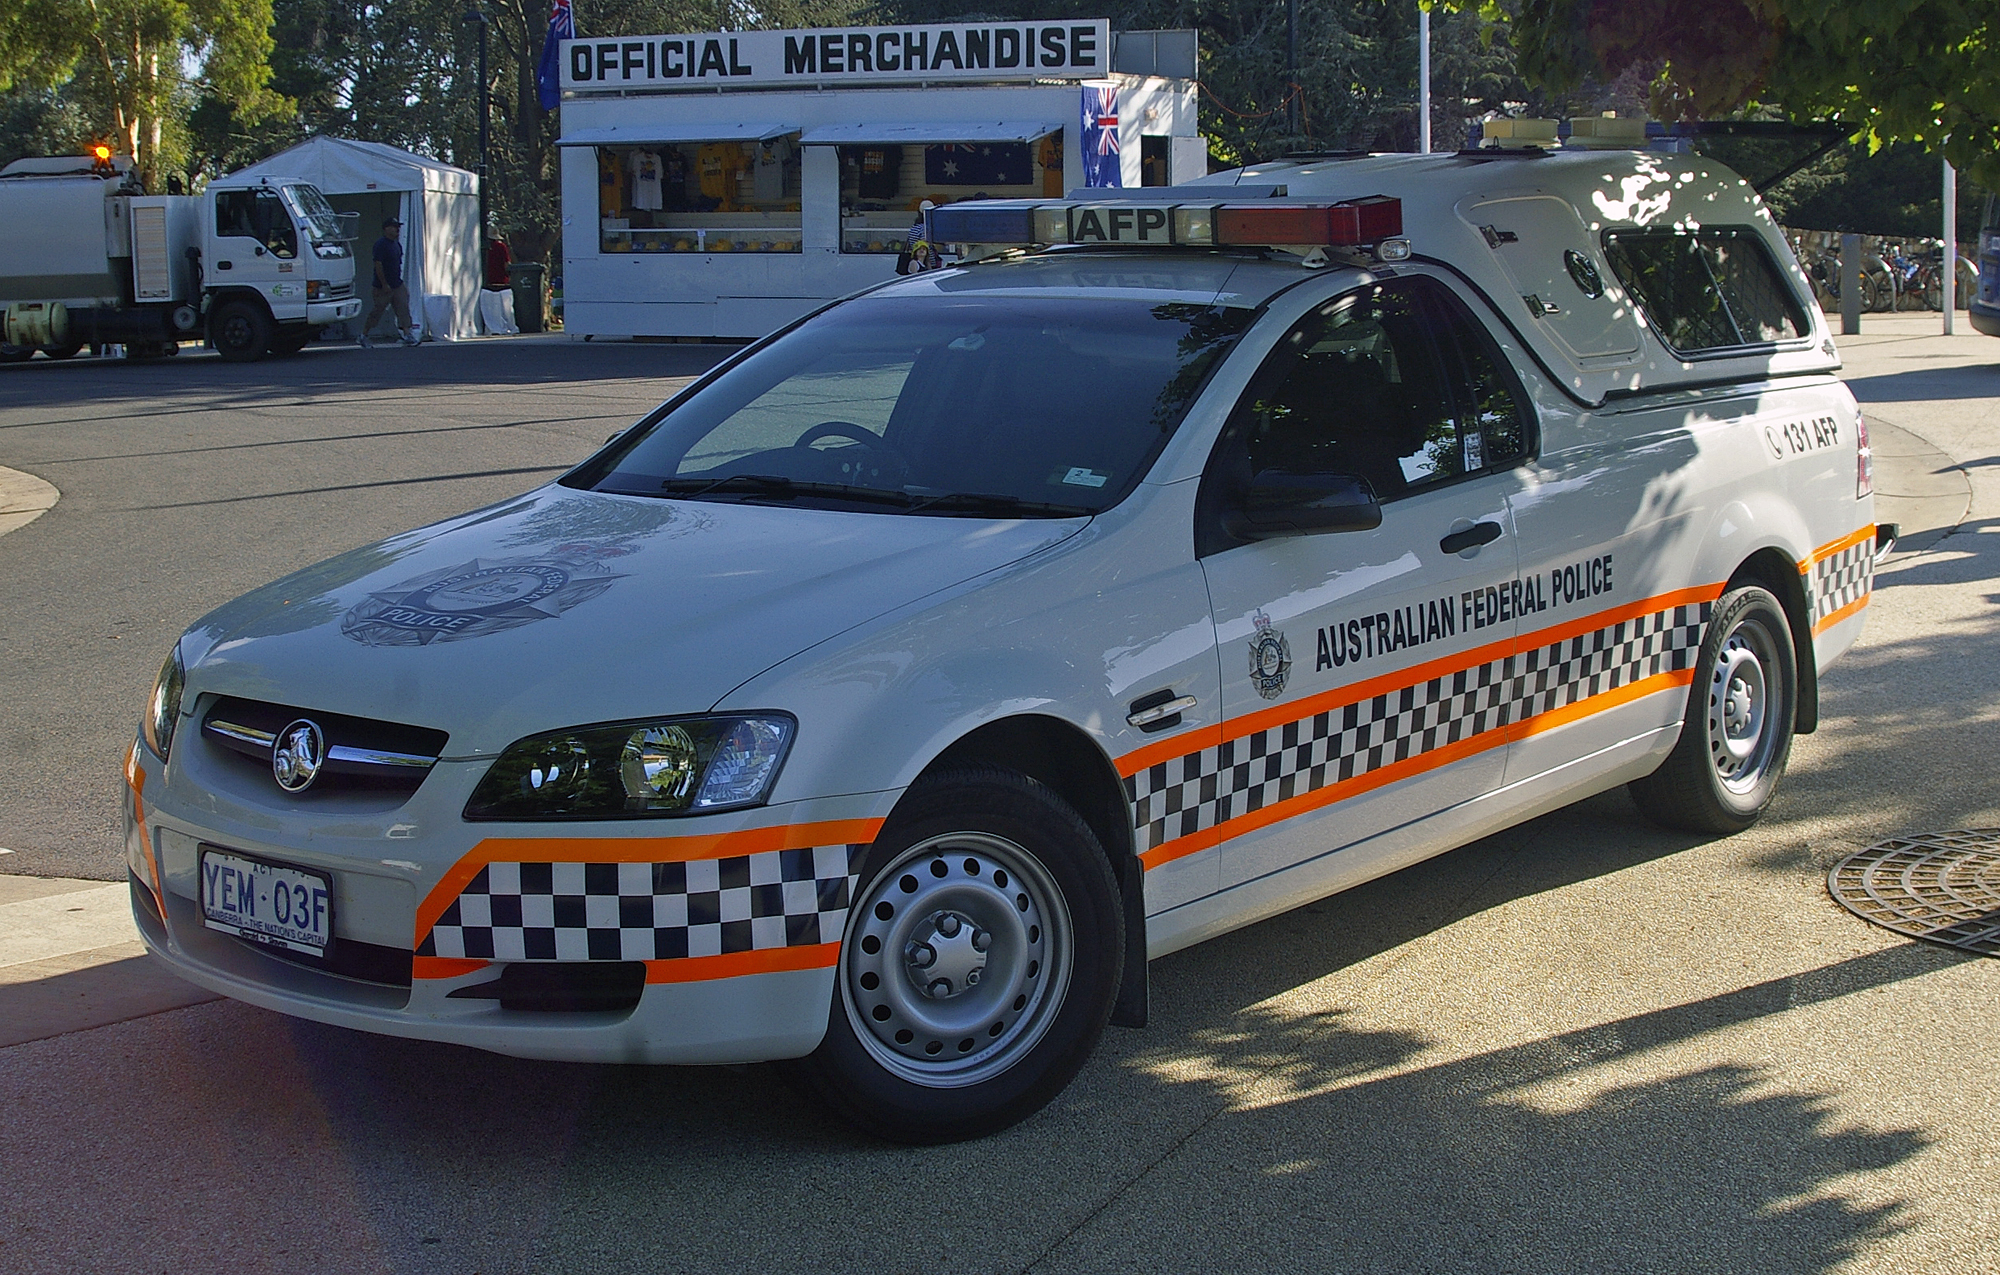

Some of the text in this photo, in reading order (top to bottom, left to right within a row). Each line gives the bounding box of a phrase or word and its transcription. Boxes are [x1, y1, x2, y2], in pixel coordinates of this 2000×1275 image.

[571, 26, 1097, 81] OFFICIAL MERCHANDISE
[1075, 208, 1167, 241] AFP
[1783, 416, 1838, 454] 131 AFP
[423, 566, 563, 603] AUSTRALIAN FEDERAL
[380, 608, 471, 629] POLICE
[1315, 595, 1456, 673] AUSTRALIAN
[1462, 573, 1547, 633] FEDERAL
[1552, 554, 1613, 608] POLICE
[253, 864, 272, 876] ACT
[206, 907, 243, 926] CANBERRA
[249, 918, 263, 931] THE
[297, 930, 325, 946] CAPITAL
